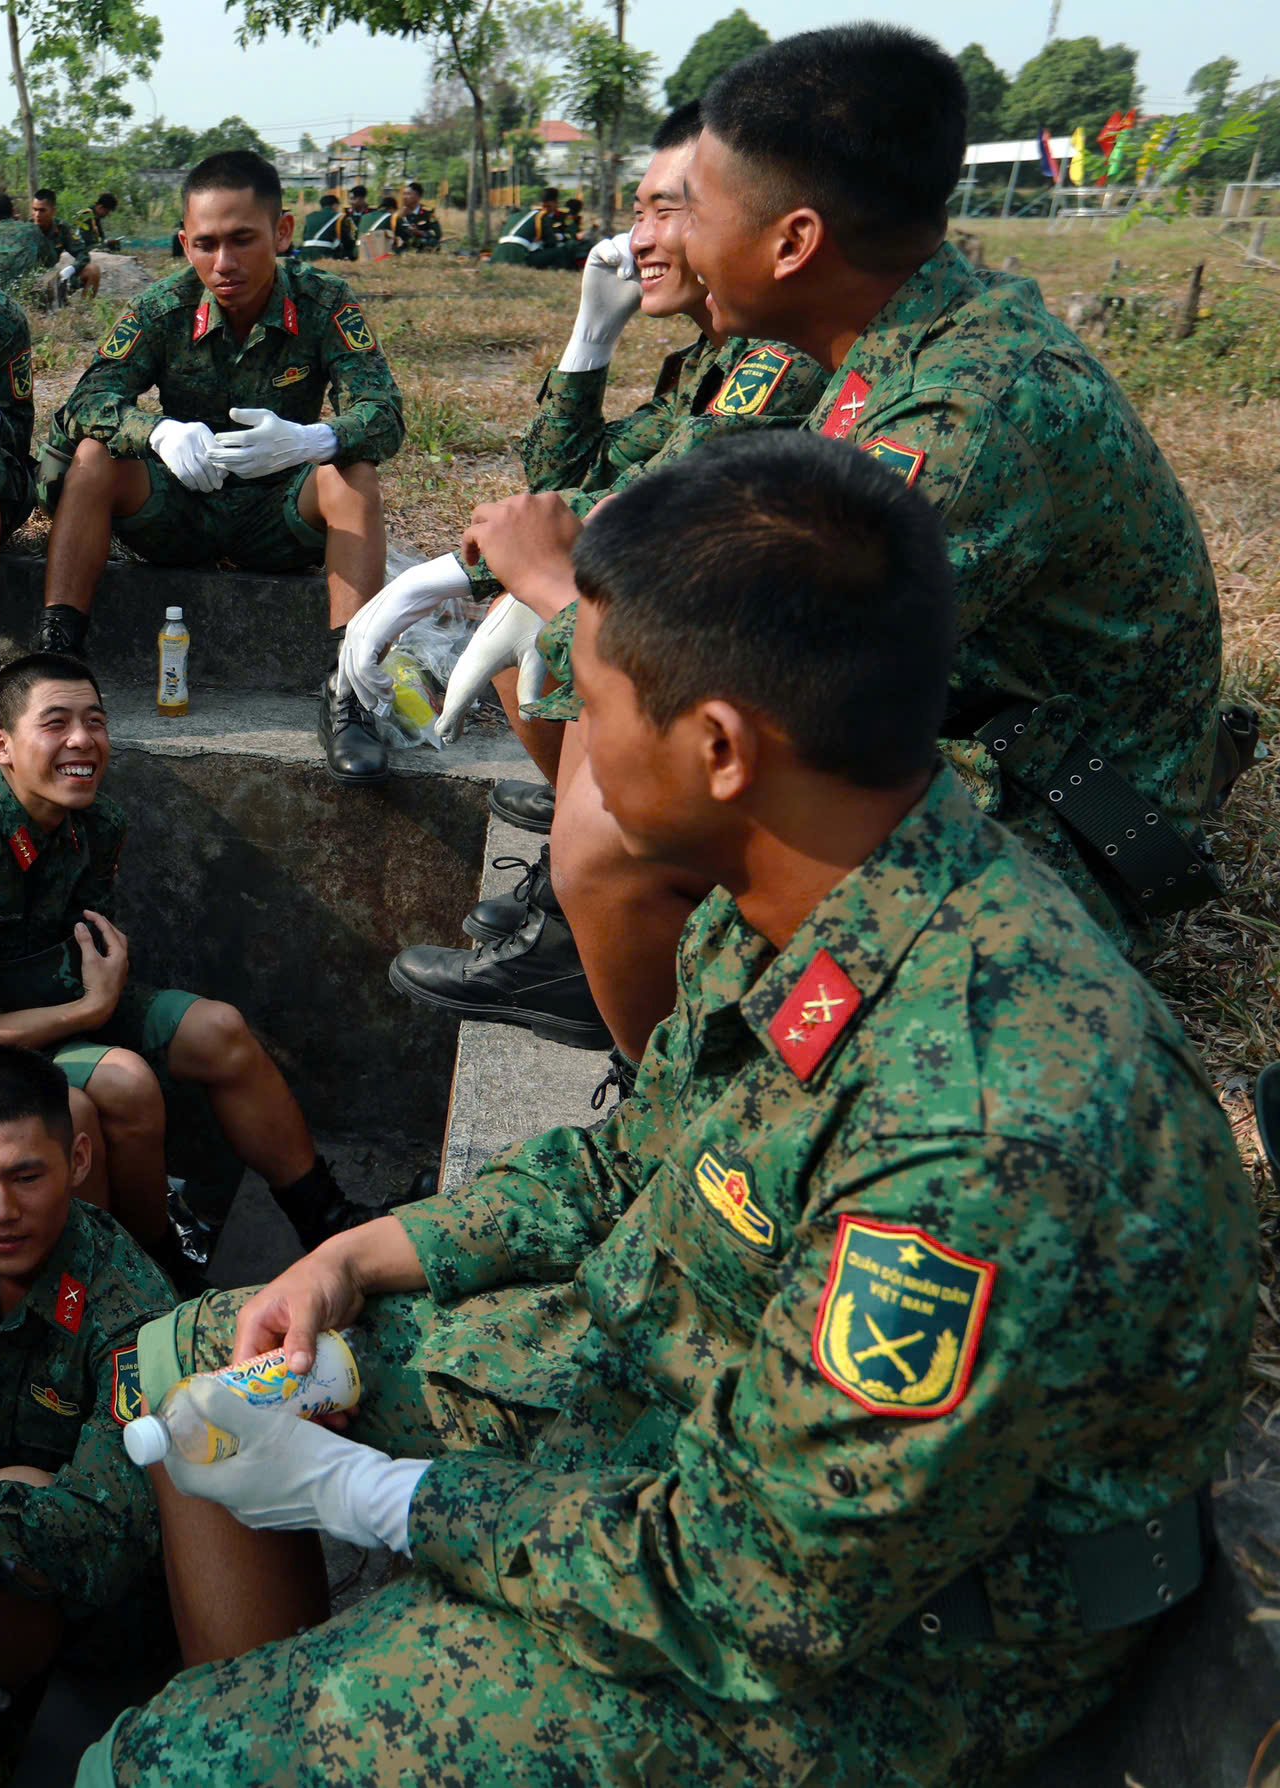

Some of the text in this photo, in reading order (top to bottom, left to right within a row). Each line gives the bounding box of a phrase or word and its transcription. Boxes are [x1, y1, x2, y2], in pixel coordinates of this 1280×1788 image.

[847, 1250, 881, 1276] QUÂN
[880, 1265, 904, 1286] ĐỘI
[940, 1286, 970, 1306] DÂN
[870, 1280, 936, 1317] VIỆT NAM
